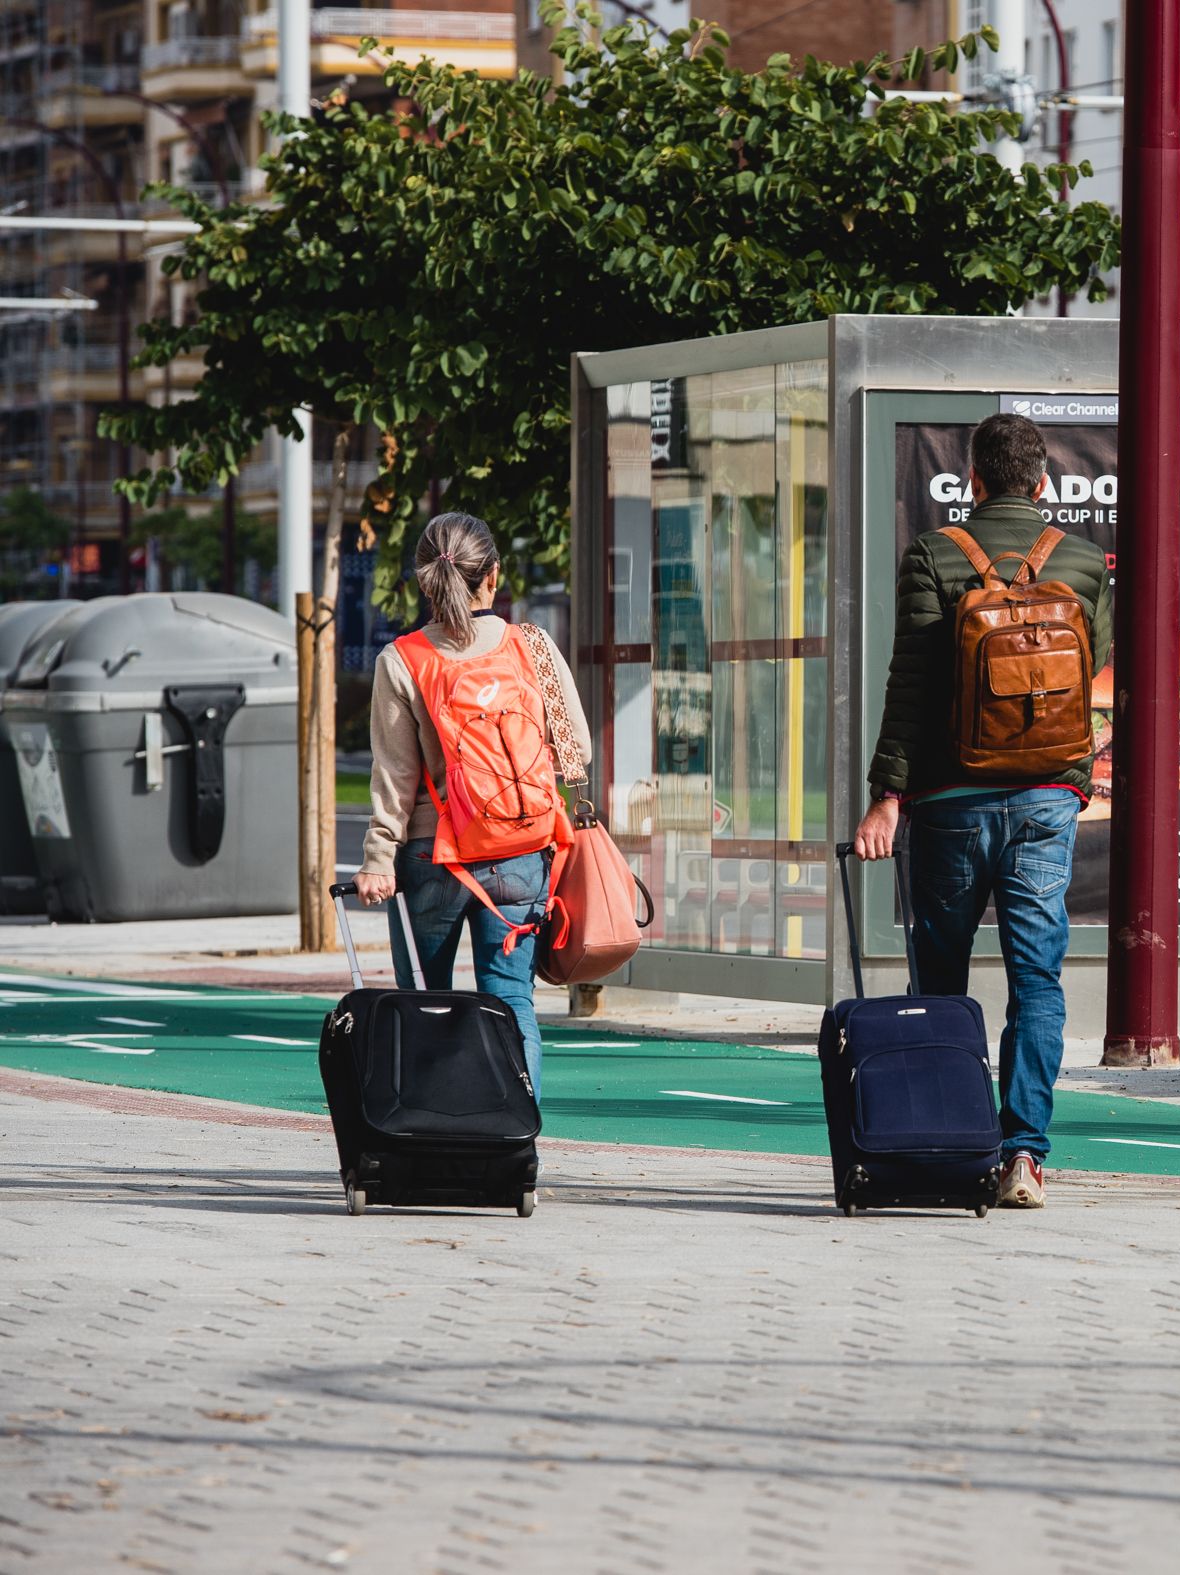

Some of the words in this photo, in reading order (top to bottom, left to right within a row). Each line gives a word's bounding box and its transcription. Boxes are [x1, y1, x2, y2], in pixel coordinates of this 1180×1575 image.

[1032, 403, 1065, 416] Clear
[1067, 403, 1119, 416] Channel
[1057, 509, 1091, 523] CUP
[1095, 510, 1103, 523] II
